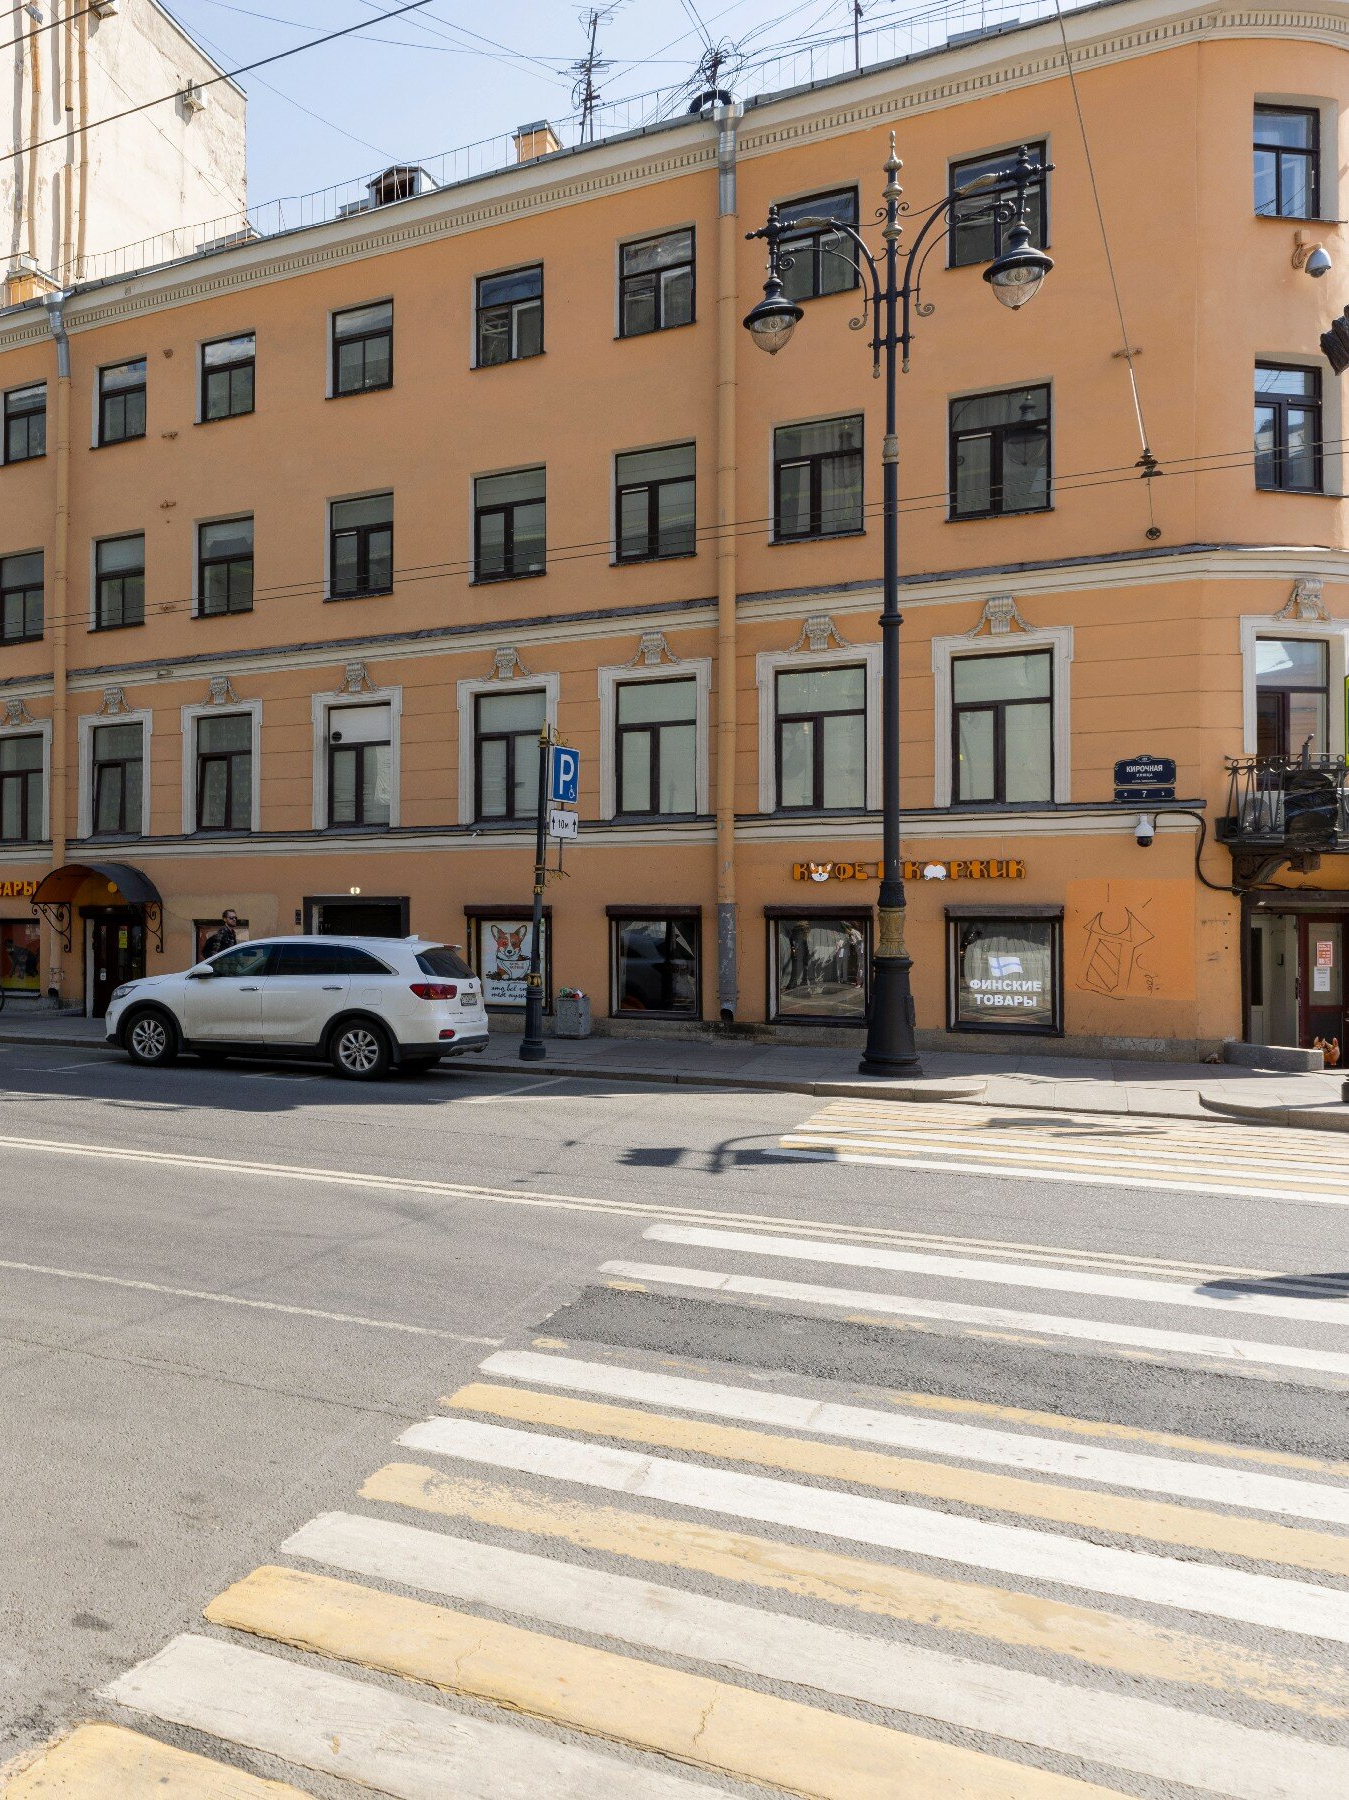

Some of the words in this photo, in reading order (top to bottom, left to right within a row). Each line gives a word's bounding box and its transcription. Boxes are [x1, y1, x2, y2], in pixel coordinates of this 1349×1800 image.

[1126, 764, 1163, 773] КИРОЧНАЯ
[1141, 790, 1148, 798] 7
[970, 979, 1042, 992] ФИНСКИЕ
[974, 994, 1037, 1007] ТОВАРЫ
